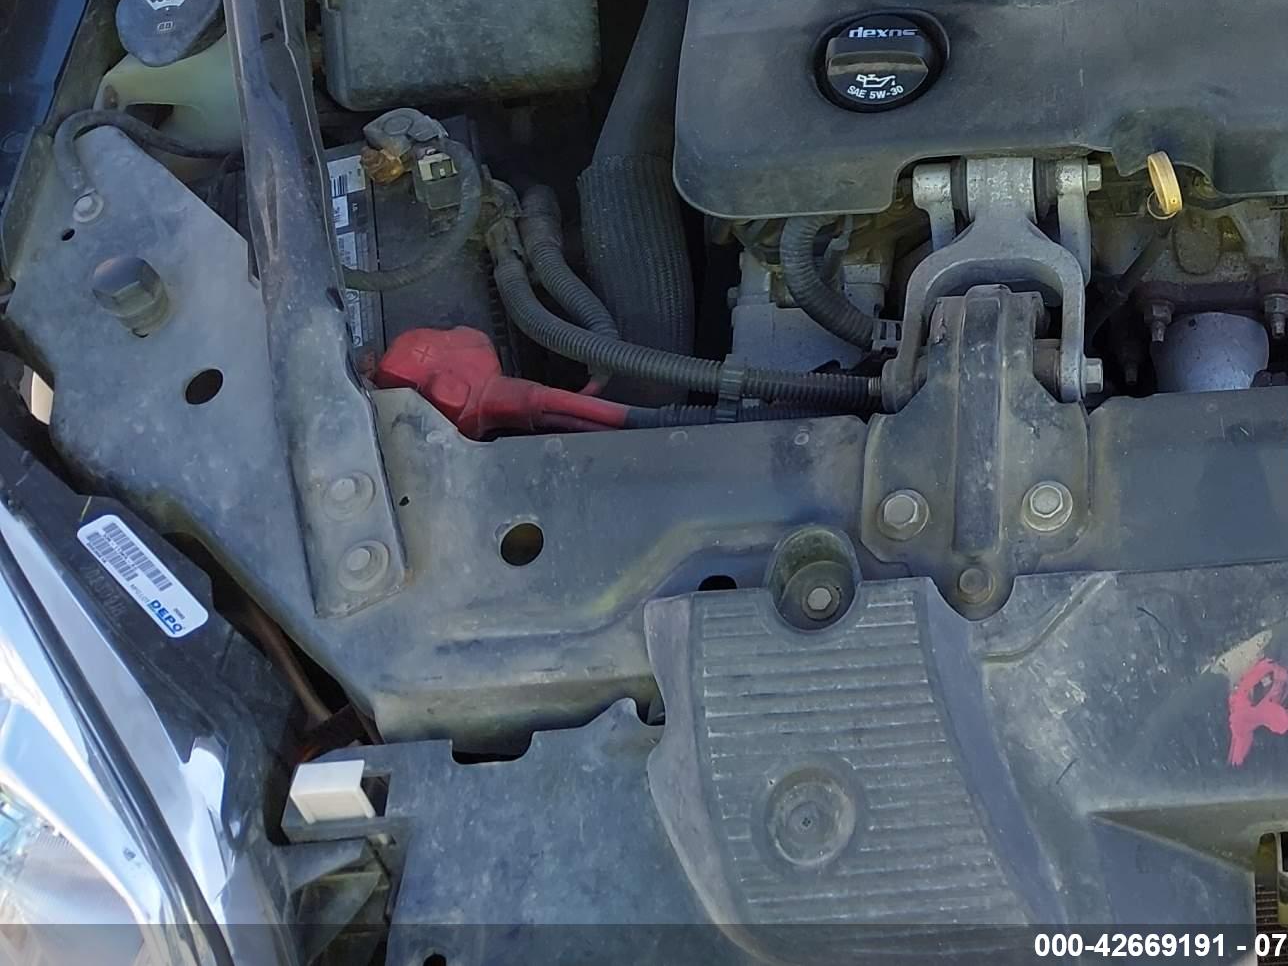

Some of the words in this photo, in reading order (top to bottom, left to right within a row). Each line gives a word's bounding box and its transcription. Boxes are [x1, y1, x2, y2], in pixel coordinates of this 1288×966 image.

[847, 85, 867, 99] SAE
[869, 85, 904, 99] 5W-30
[149, 599, 183, 634] DEPO
